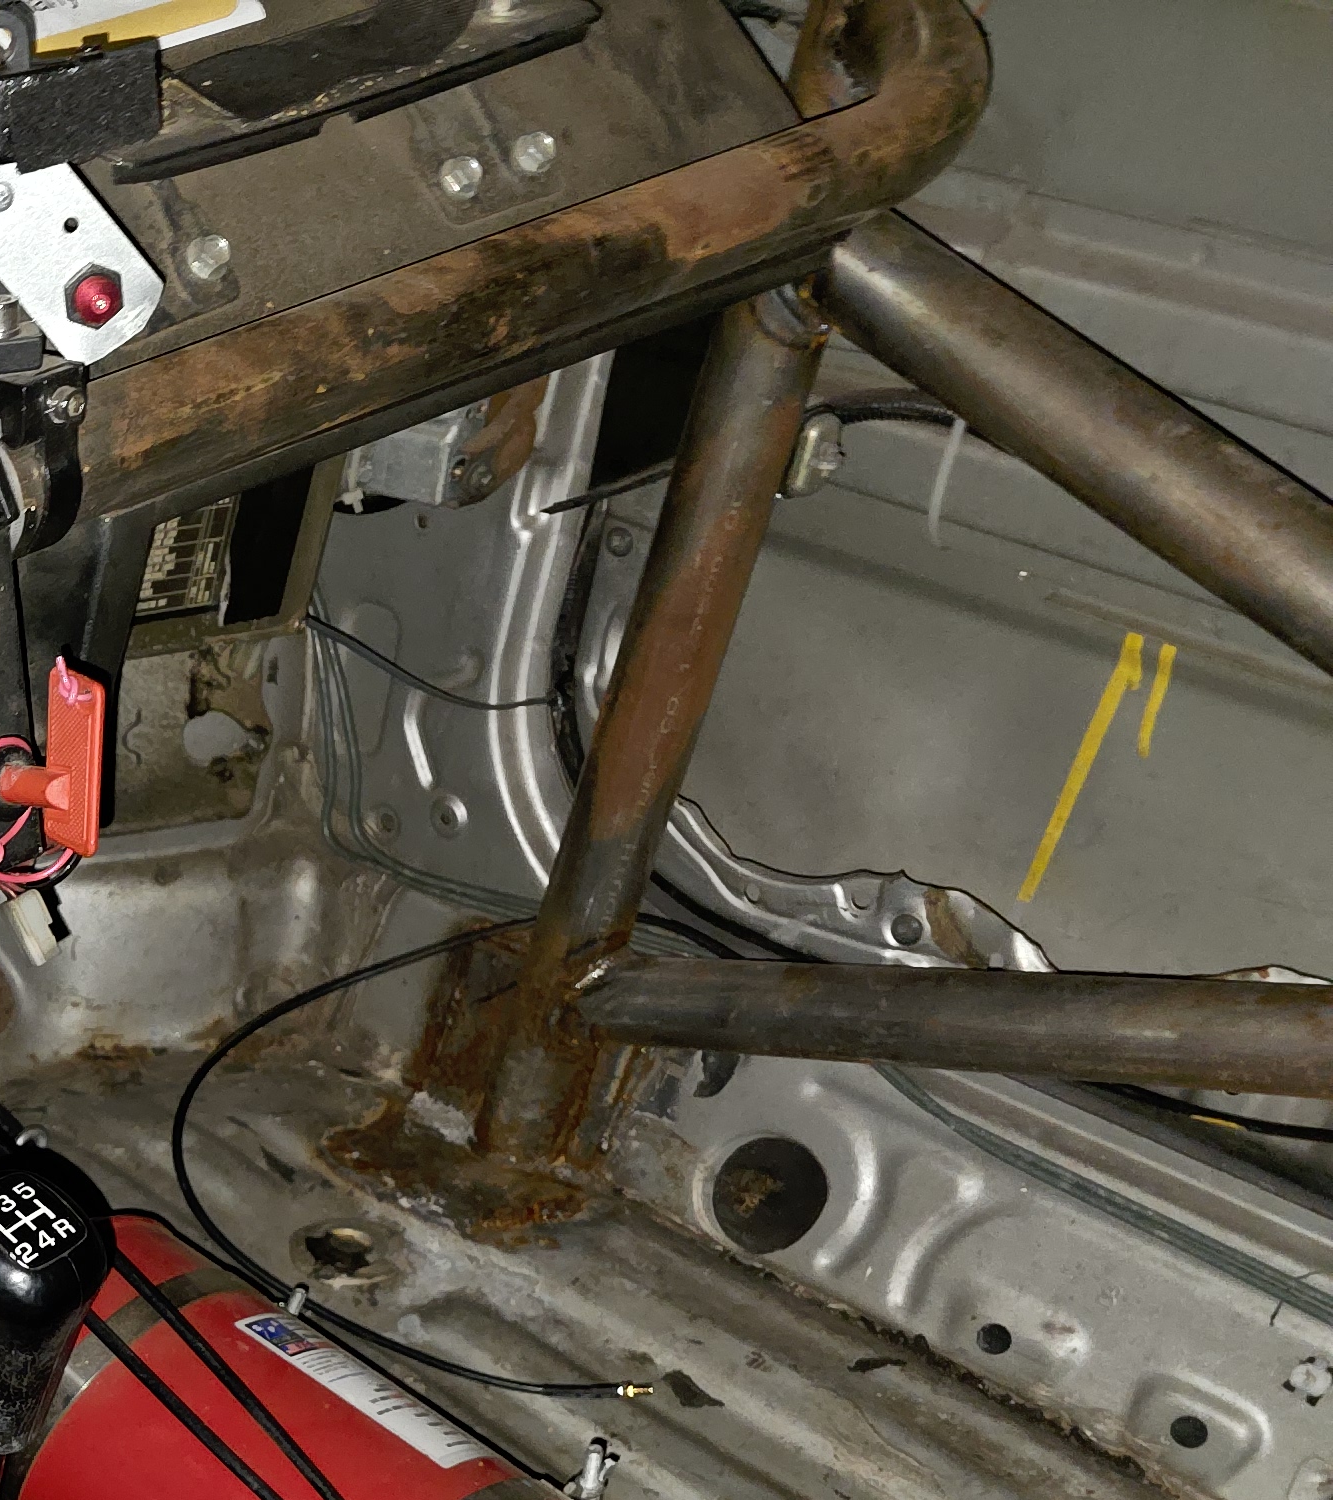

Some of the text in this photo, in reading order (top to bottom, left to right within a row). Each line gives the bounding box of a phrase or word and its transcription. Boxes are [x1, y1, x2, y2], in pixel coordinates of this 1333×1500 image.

[12, 1181, 36, 1200] 5
[52, 1218, 77, 1239] R
[38, 1229, 56, 1249] 4
[14, 1242, 39, 1264] 2
